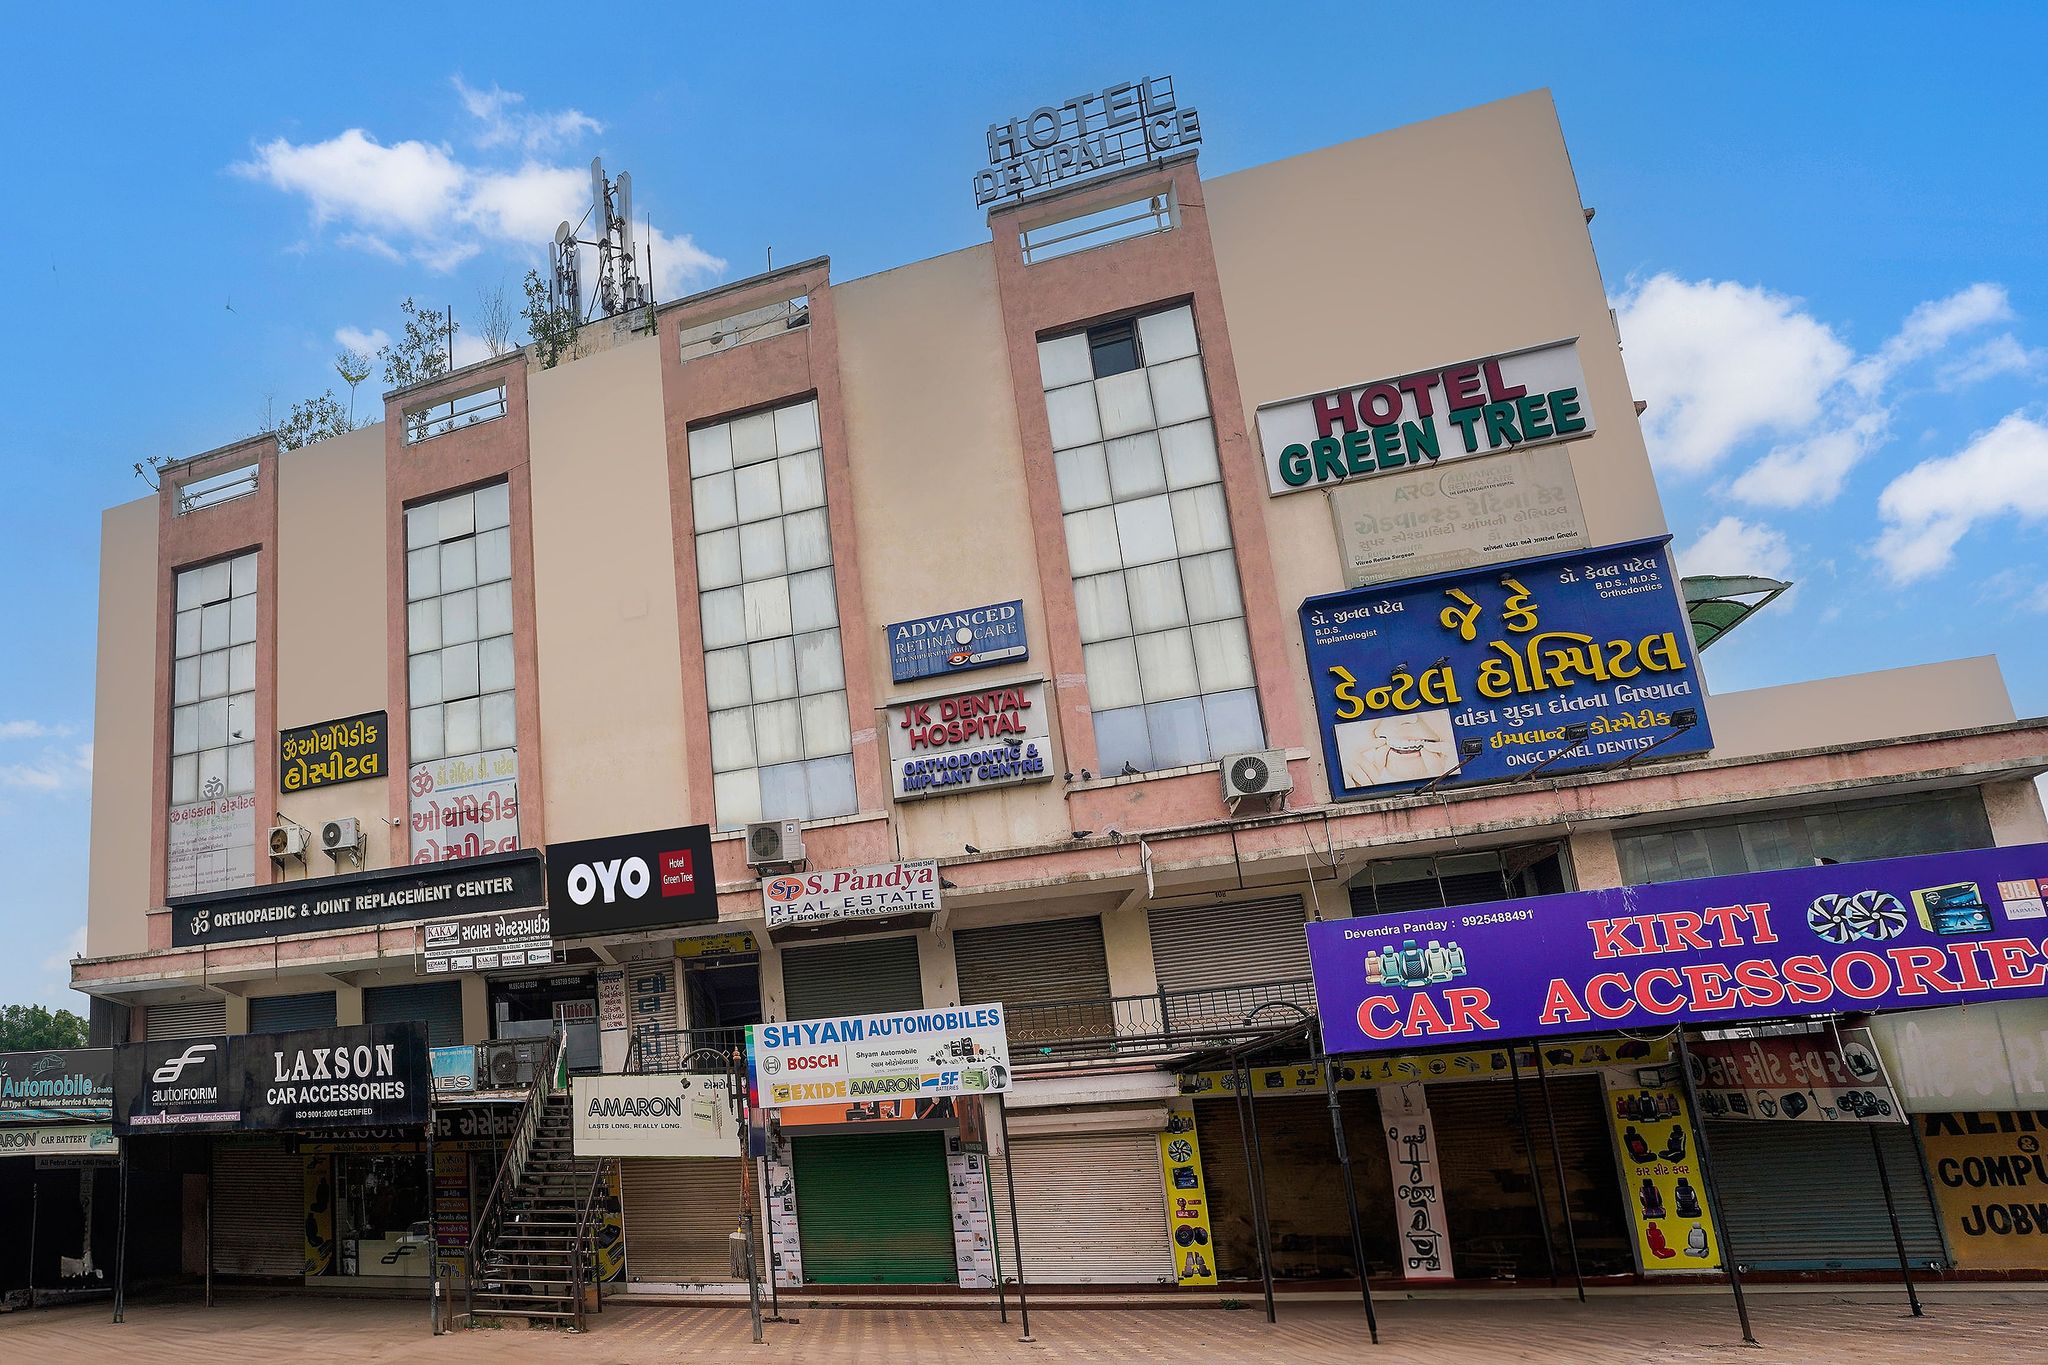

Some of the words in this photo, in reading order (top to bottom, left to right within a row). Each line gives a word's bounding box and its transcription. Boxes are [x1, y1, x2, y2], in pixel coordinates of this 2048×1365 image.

[988, 76, 1176, 163] HOTEL
[1311, 360, 1527, 439] HOTEL
[1279, 416, 1441, 487] GREEN
[1448, 387, 1586, 453] TREE
[1584, 565, 1620, 580] કેવલ
[1622, 557, 1658, 574] પટેલ
[1629, 573, 1660, 585] M.D.S.
[1600, 582, 1663, 599] Orthodontics
[1374, 600, 1405, 615] પટેલ
[1439, 588, 1483, 641] જે
[1501, 579, 1539, 633] કે
[896, 606, 1015, 641] ADVANCED
[1315, 626, 1342, 637] B.D.S.
[896, 633, 955, 655] RETINA
[974, 621, 1017, 640] CARE
[1316, 629, 1378, 646] Implantologist
[1328, 665, 1463, 719] ડેન્ટલ
[1476, 631, 1687, 698] હોસ્પિટલ
[901, 703, 931, 729] JK
[940, 687, 1031, 721] DENTAL
[1454, 708, 1497, 728] વાંકા
[1548, 694, 1609, 715] દાંતના
[910, 711, 1027, 750] HOSPITAL
[904, 746, 1021, 776] ORTHODONTIC
[1026, 743, 1039, 758] &
[1506, 750, 1545, 767] ONGC
[1548, 744, 1594, 760] PANEL
[1597, 736, 1655, 755] DENTIST
[284, 751, 378, 790] હોસ્પીટલ
[903, 767, 973, 792] IMPLANT
[978, 757, 1044, 781] CENTRE
[668, 857, 685, 869] Hotel
[567, 856, 651, 906] OYO
[663, 873, 680, 885] Green
[681, 872, 693, 883] Tree
[214, 905, 296, 927] ORTHOPAEDIC
[300, 903, 310, 917] &
[313, 898, 351, 915] JOINT
[356, 884, 452, 910] REPLACEMENT
[456, 877, 514, 896] CENTER
[771, 900, 831, 916] REAL
[844, 889, 934, 907] ESTATE
[797, 910, 829, 920] Broker
[833, 909, 840, 917] &
[843, 907, 875, 916] Estate
[878, 900, 935, 913] Consultant
[428, 924, 452, 937] KAKA
[1344, 925, 1401, 940] Devendra
[1403, 919, 1448, 934] Panday
[1461, 909, 1534, 928] 9925488491
[1587, 902, 1778, 960] KIRTI
[1357, 987, 1500, 1040] CAR
[1538, 936, 2048, 1025] ACCESSORIE
[763, 1019, 864, 1049] SHYAM
[868, 1008, 1001, 1037] AUTOMOBILES
[273, 1044, 394, 1082] LAXSON
[787, 1054, 839, 1071] BOSCH
[855, 1050, 878, 1060] Shyam
[880, 1048, 918, 1056] Automobile
[1707, 1056, 1743, 1086] કાર
[1743, 1040, 1788, 1085] સીટ
[1789, 1050, 1847, 1085] કવર
[2, 1074, 93, 1097] Automobile
[703, 1078, 729, 1089] એમરો
[791, 1081, 847, 1100] EXIDE
[850, 1077, 920, 1096] AMARON
[941, 1072, 959, 1086] SF
[9, 1100, 21, 1108] Type
[62, 1098, 81, 1106] Service
[87, 1098, 113, 1106] Repairing
[266, 1087, 297, 1105] CAR
[299, 1081, 405, 1104] ACCESSORIES
[198, 1113, 238, 1121] Manufacturer
[338, 1108, 373, 1117] CERTIFIED
[588, 1096, 682, 1117] AMARON
[0, 1132, 37, 1148] ARON
[41, 1136, 55, 1144] CAR
[56, 1135, 88, 1143] BATTERY
[1636, 1166, 1650, 1176] કાર
[1653, 1165, 1670, 1175] સીટ
